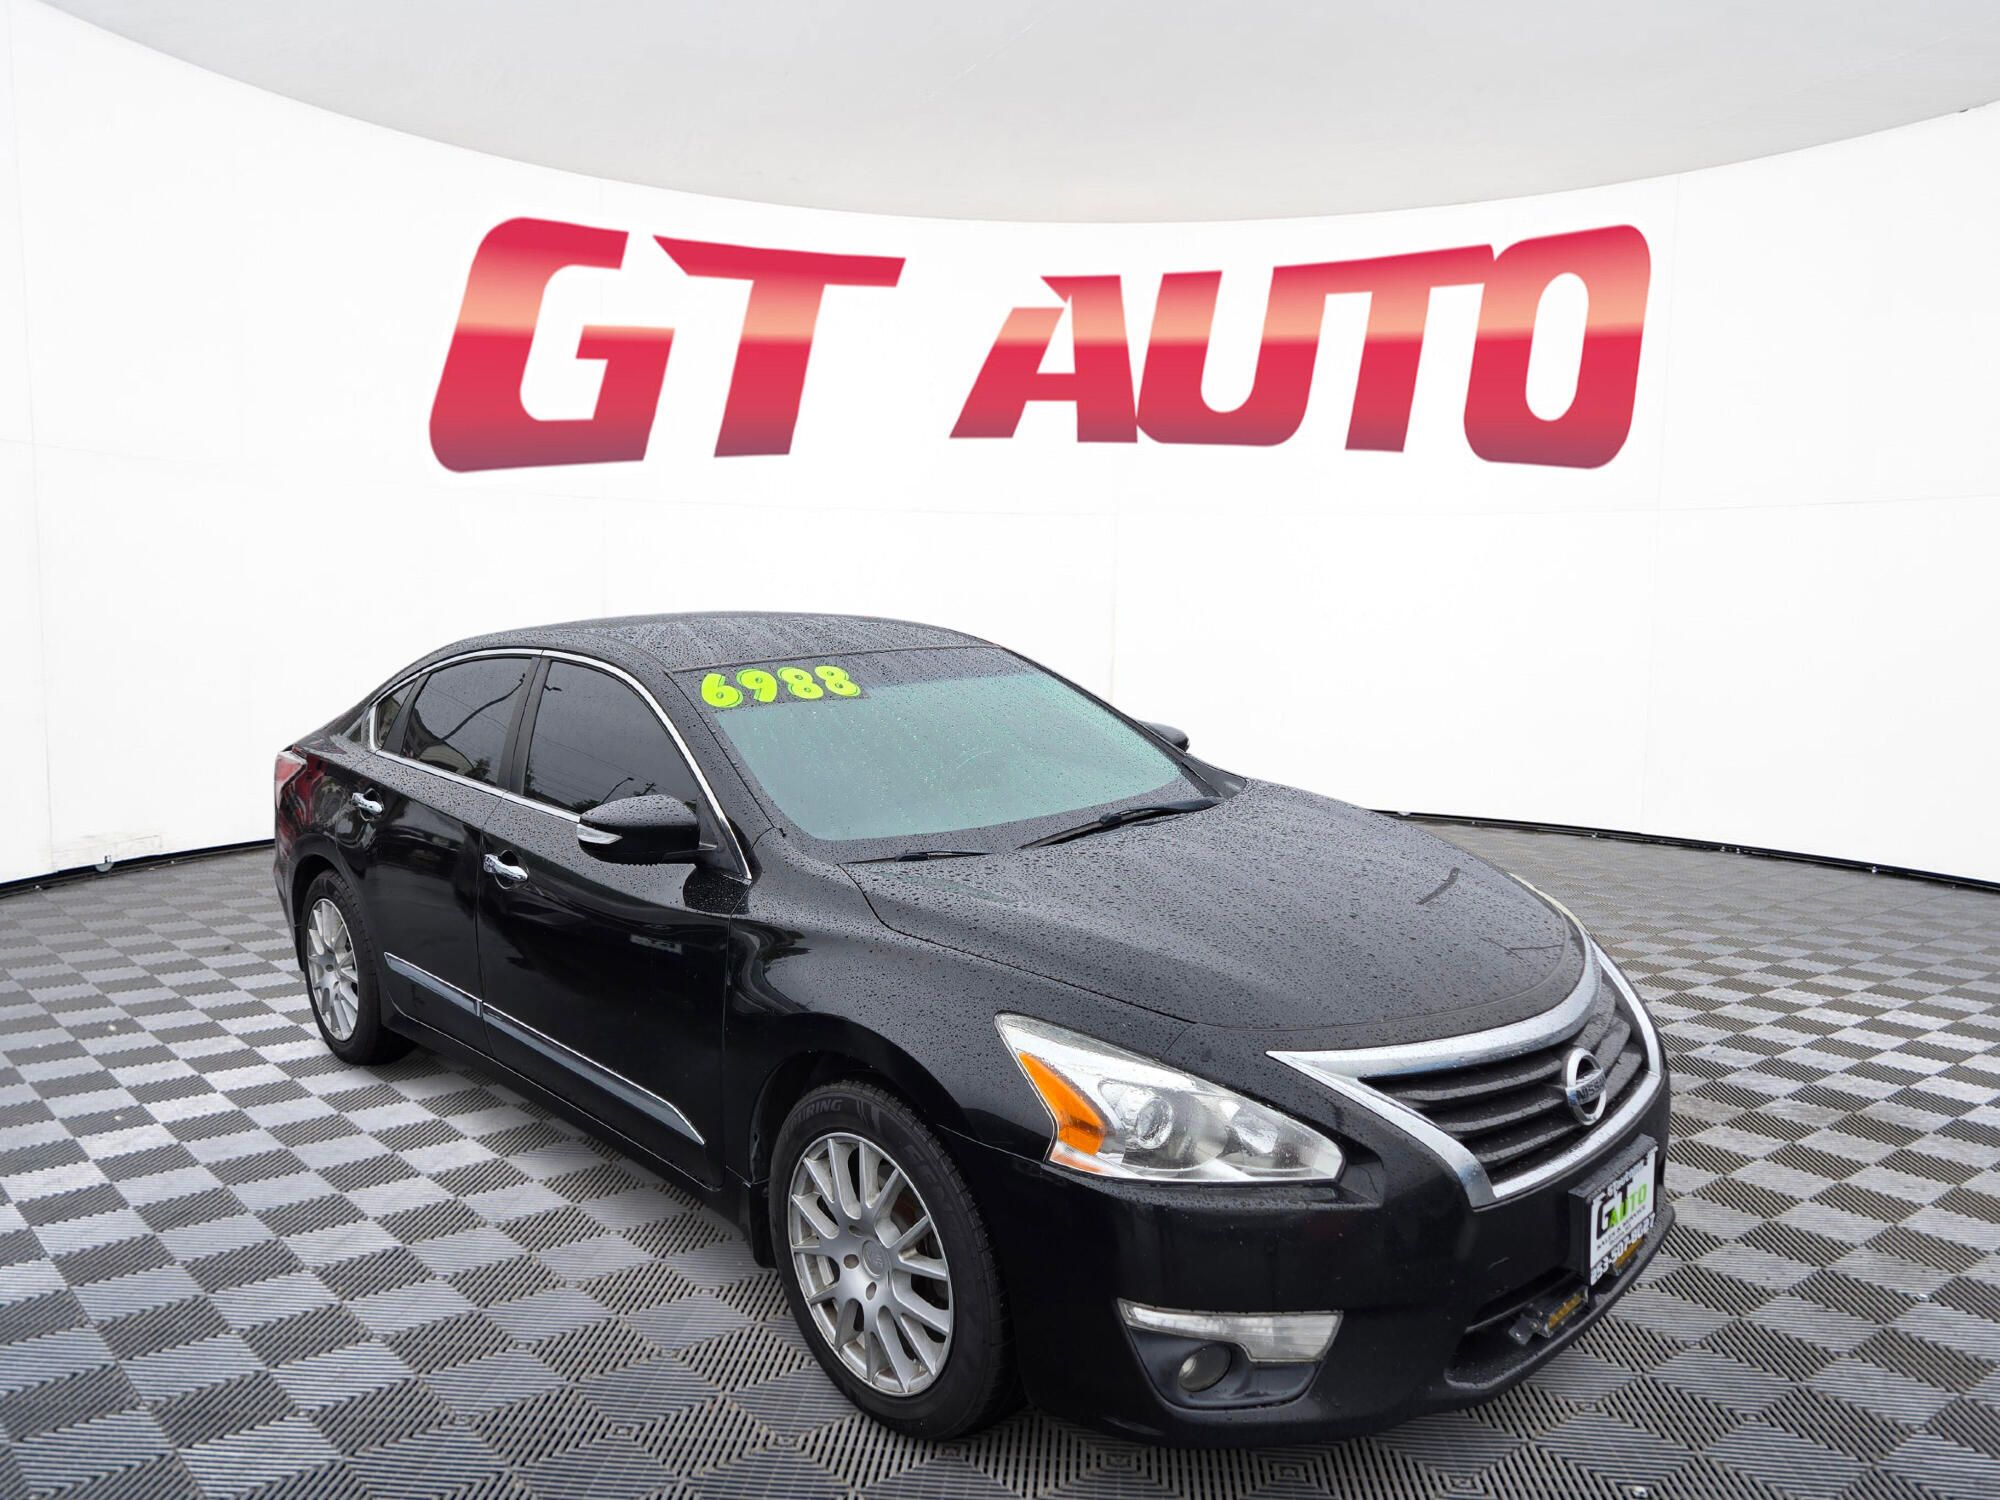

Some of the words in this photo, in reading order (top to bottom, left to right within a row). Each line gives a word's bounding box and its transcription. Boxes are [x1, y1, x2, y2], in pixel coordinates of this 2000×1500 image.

[429, 217, 905, 473] GT
[949, 224, 1651, 469] AUTO
[701, 665, 861, 708] 6988
